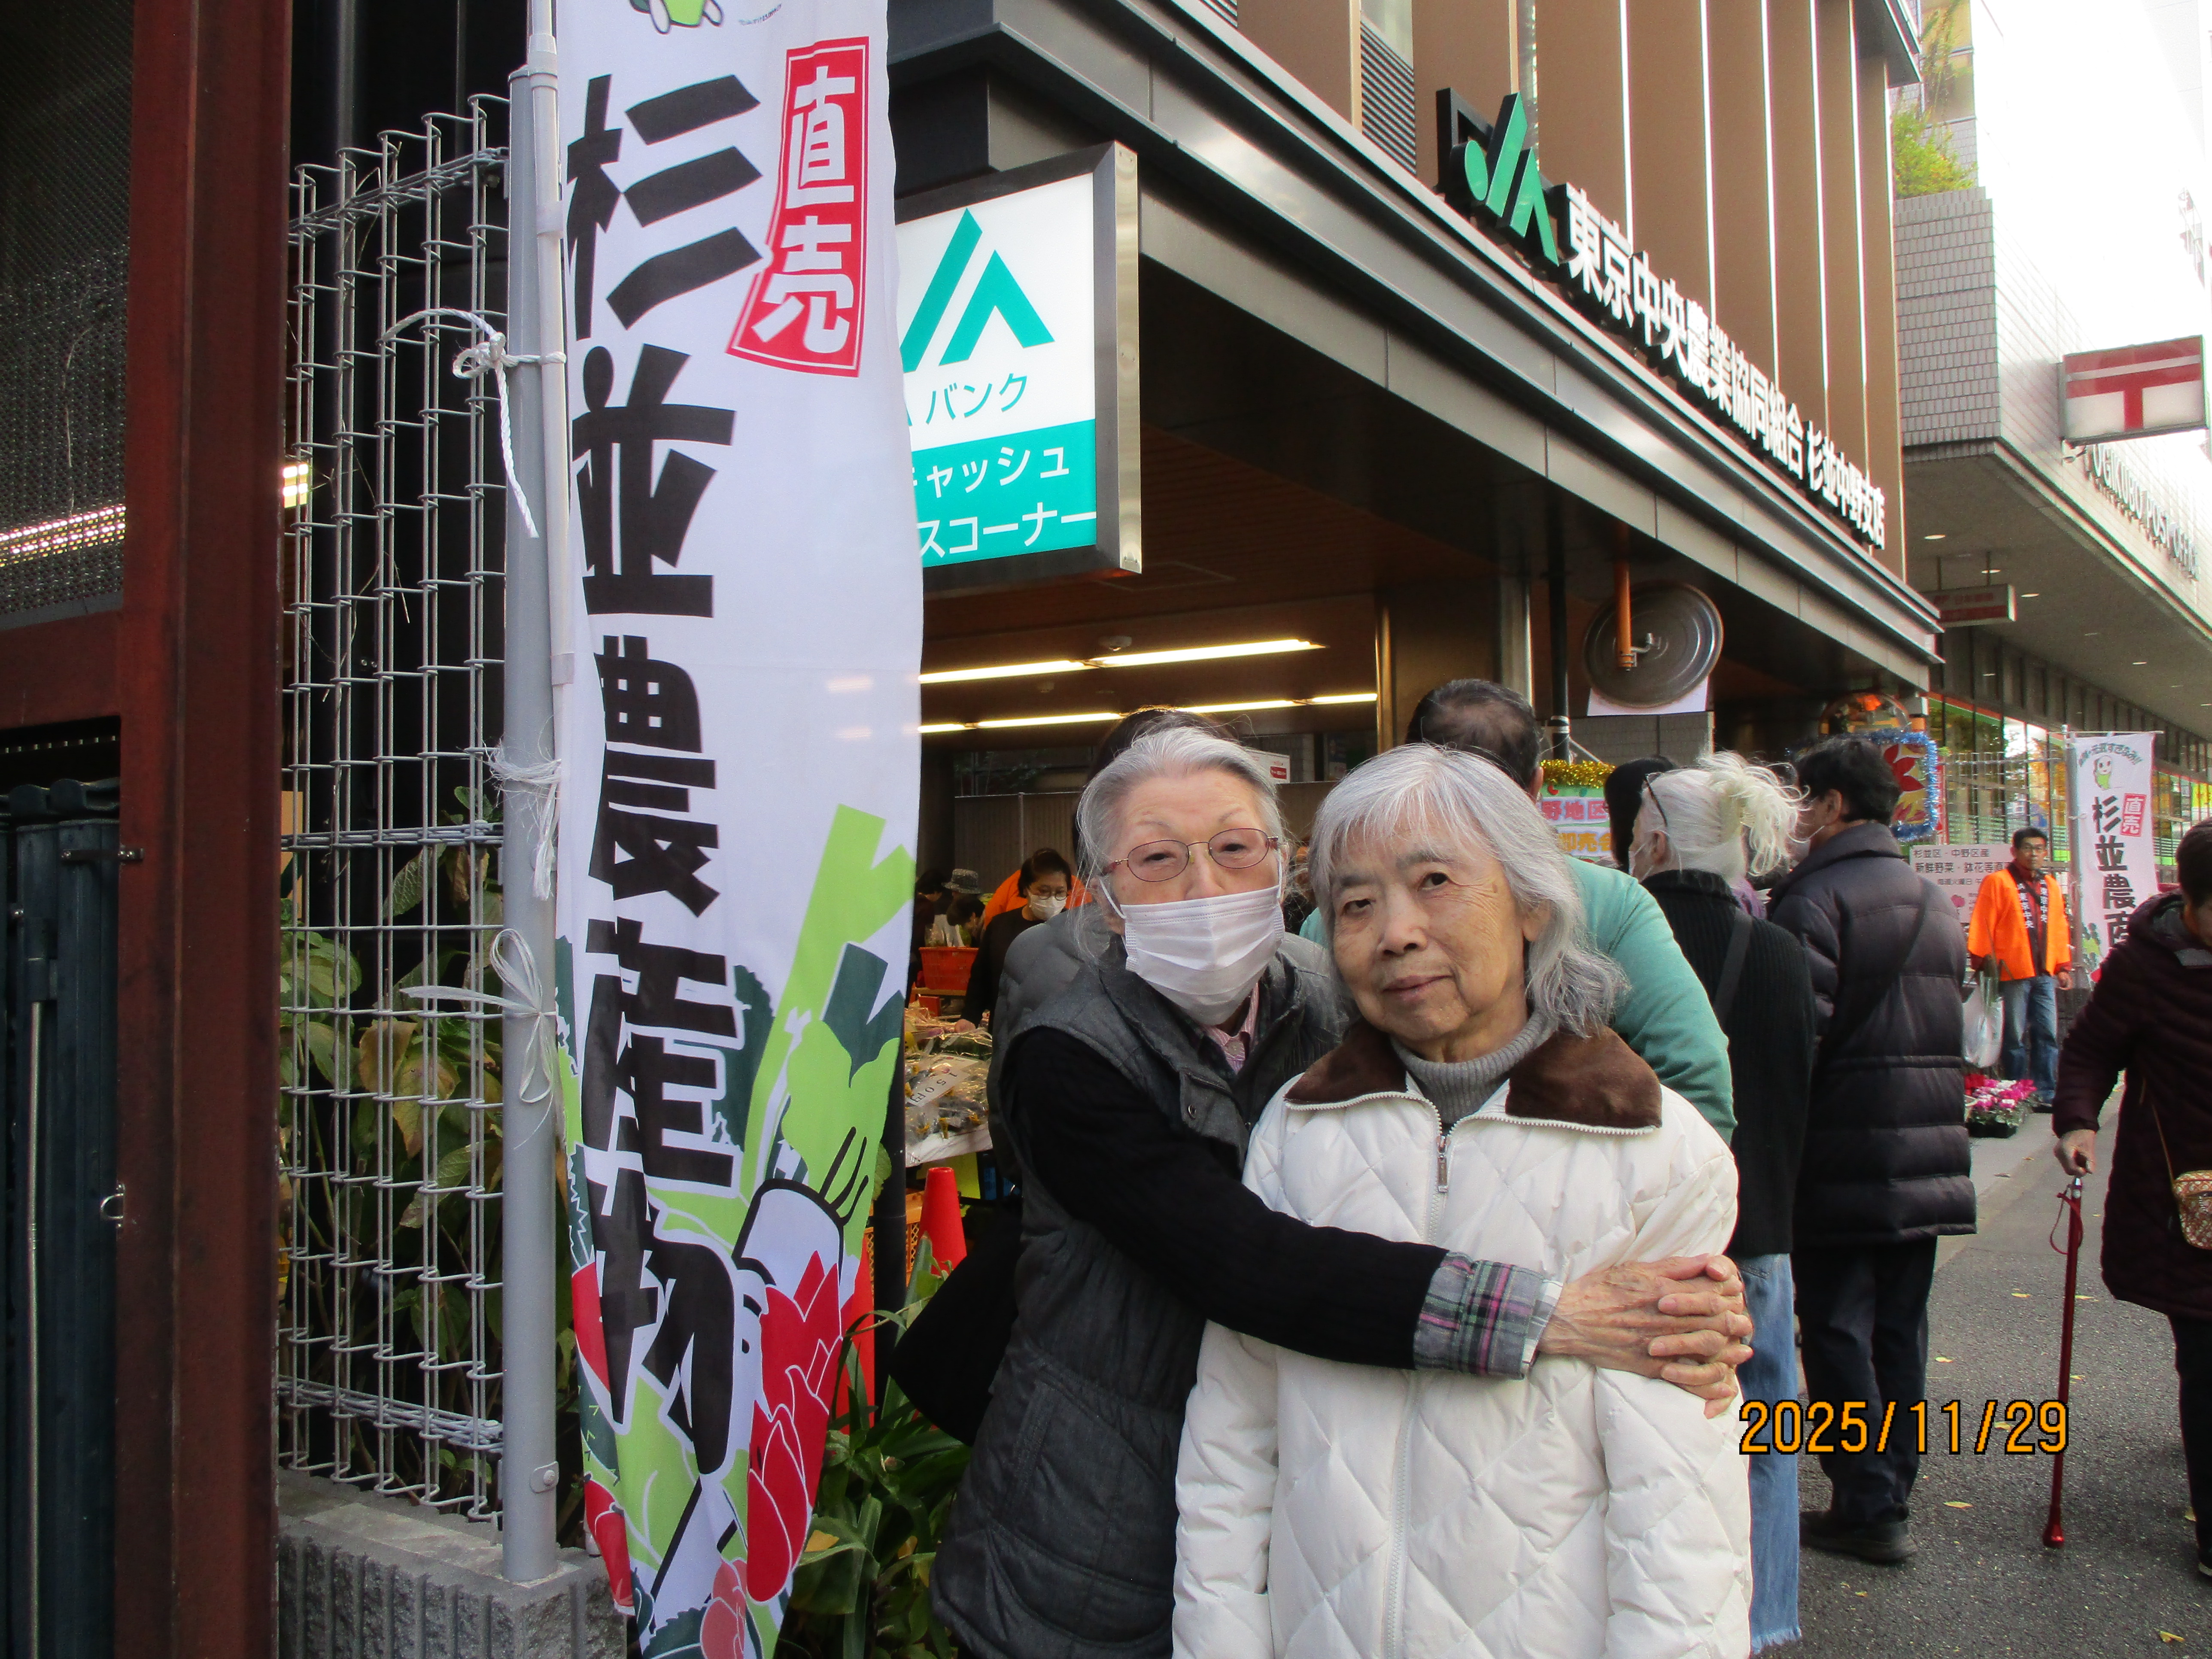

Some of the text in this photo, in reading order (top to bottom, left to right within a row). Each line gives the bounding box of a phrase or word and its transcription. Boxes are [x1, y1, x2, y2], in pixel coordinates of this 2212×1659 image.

[750, 65, 856, 354] 直売
[907, 373, 1028, 426] バンク
[1566, 182, 1803, 480] 東京中央農業協同組合
[2122, 797, 2144, 834] 直売
